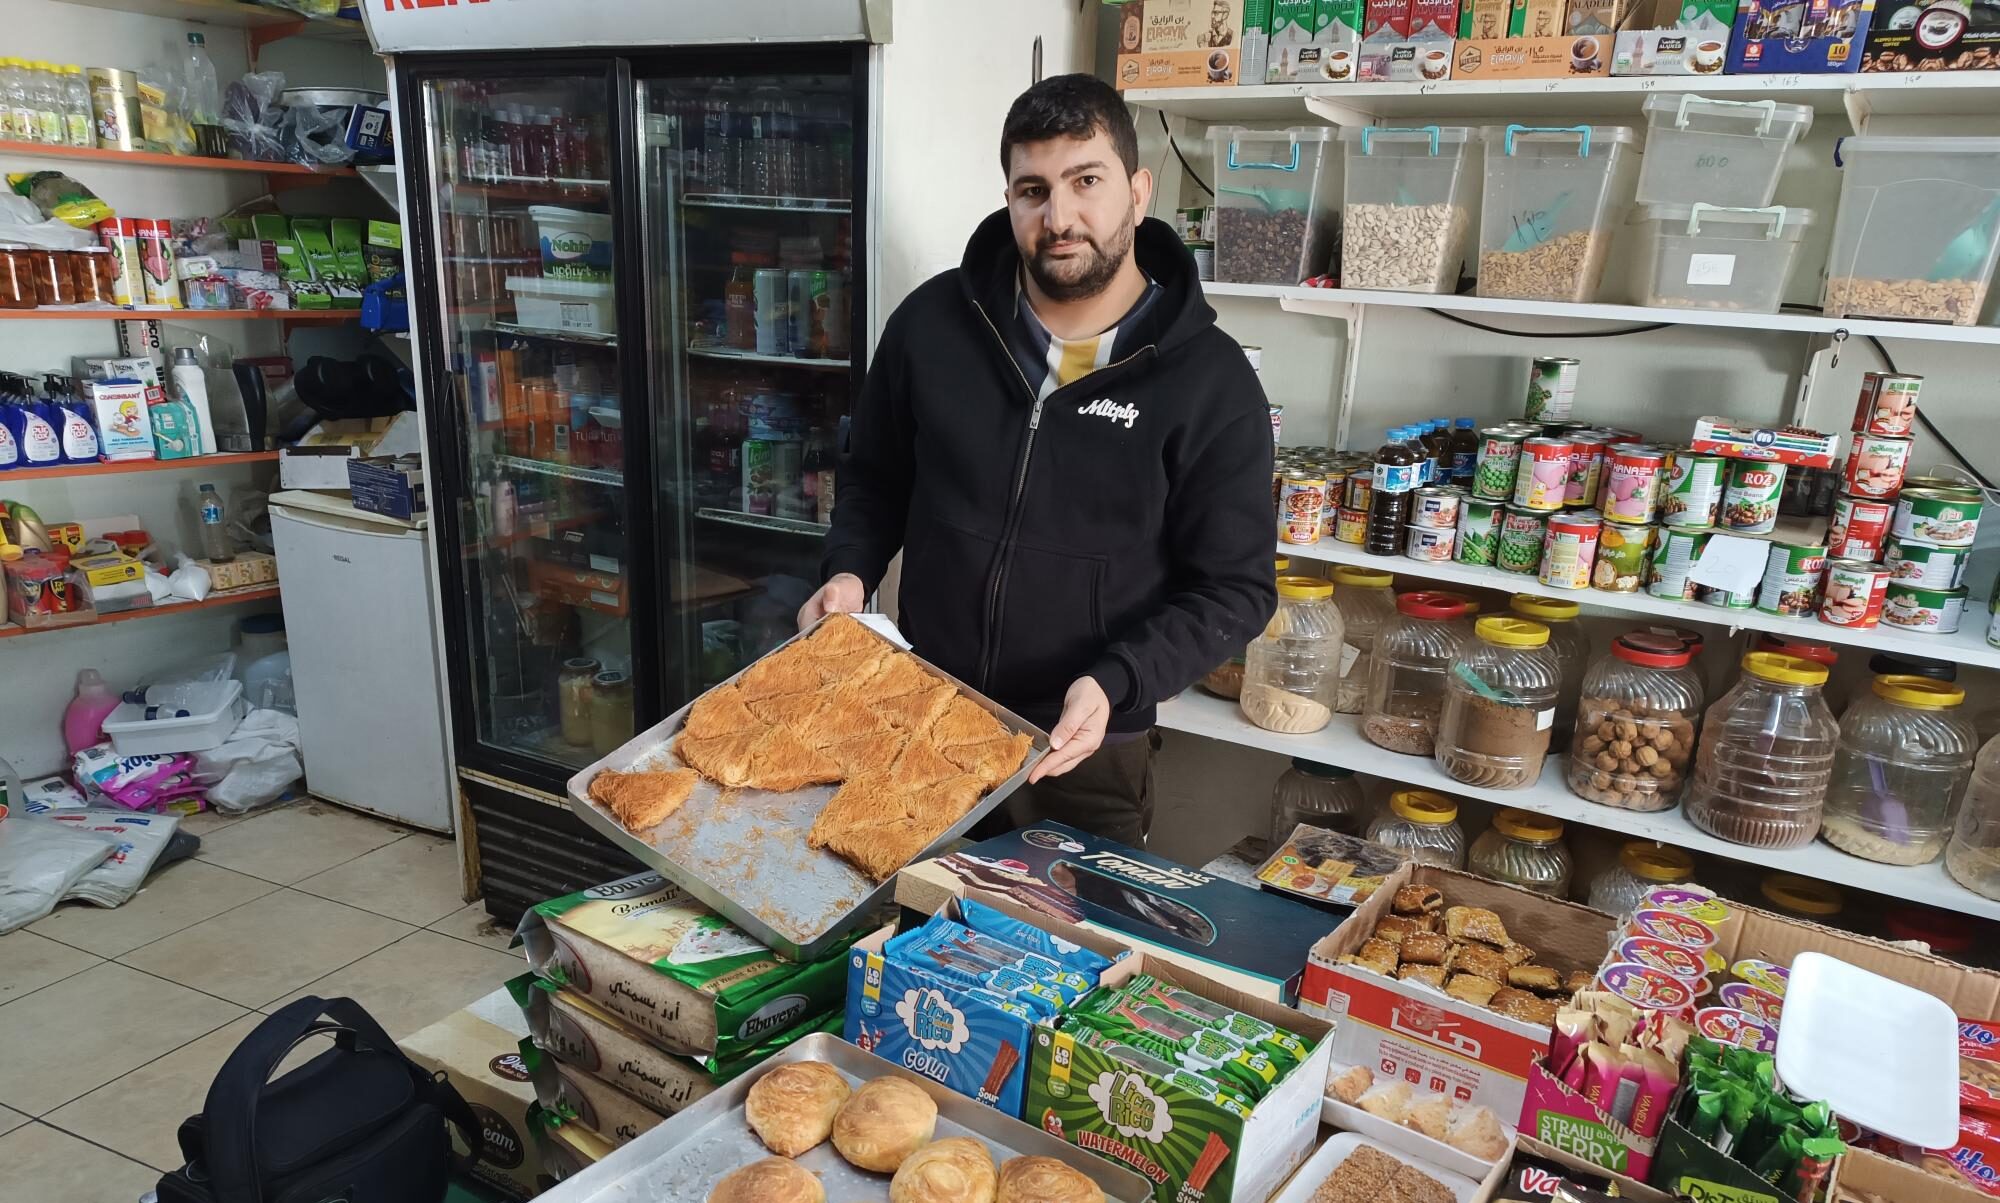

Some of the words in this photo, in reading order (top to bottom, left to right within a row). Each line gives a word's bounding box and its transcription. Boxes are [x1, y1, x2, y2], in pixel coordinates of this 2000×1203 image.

[1834, 45, 1845, 54] 10
[1613, 464, 1640, 475] HANA
[1744, 472, 1772, 485] ROZ
[744, 1003, 801, 1038] Ebuveys
[914, 988, 955, 1022] Lico
[913, 1011, 954, 1043] Rico
[903, 1047, 950, 1083] COLA
[978, 1086, 1000, 1103] Sour
[1109, 1072, 1155, 1111] Lico
[1108, 1096, 1155, 1132] Rico
[1541, 1115, 1594, 1141] STRAW
[1633, 1095, 1653, 1134] VANELLI
[1077, 1129, 1170, 1185] WATERMELON
[1540, 1128, 1625, 1170] BERRY
[1181, 1181, 1205, 1202] Sour
